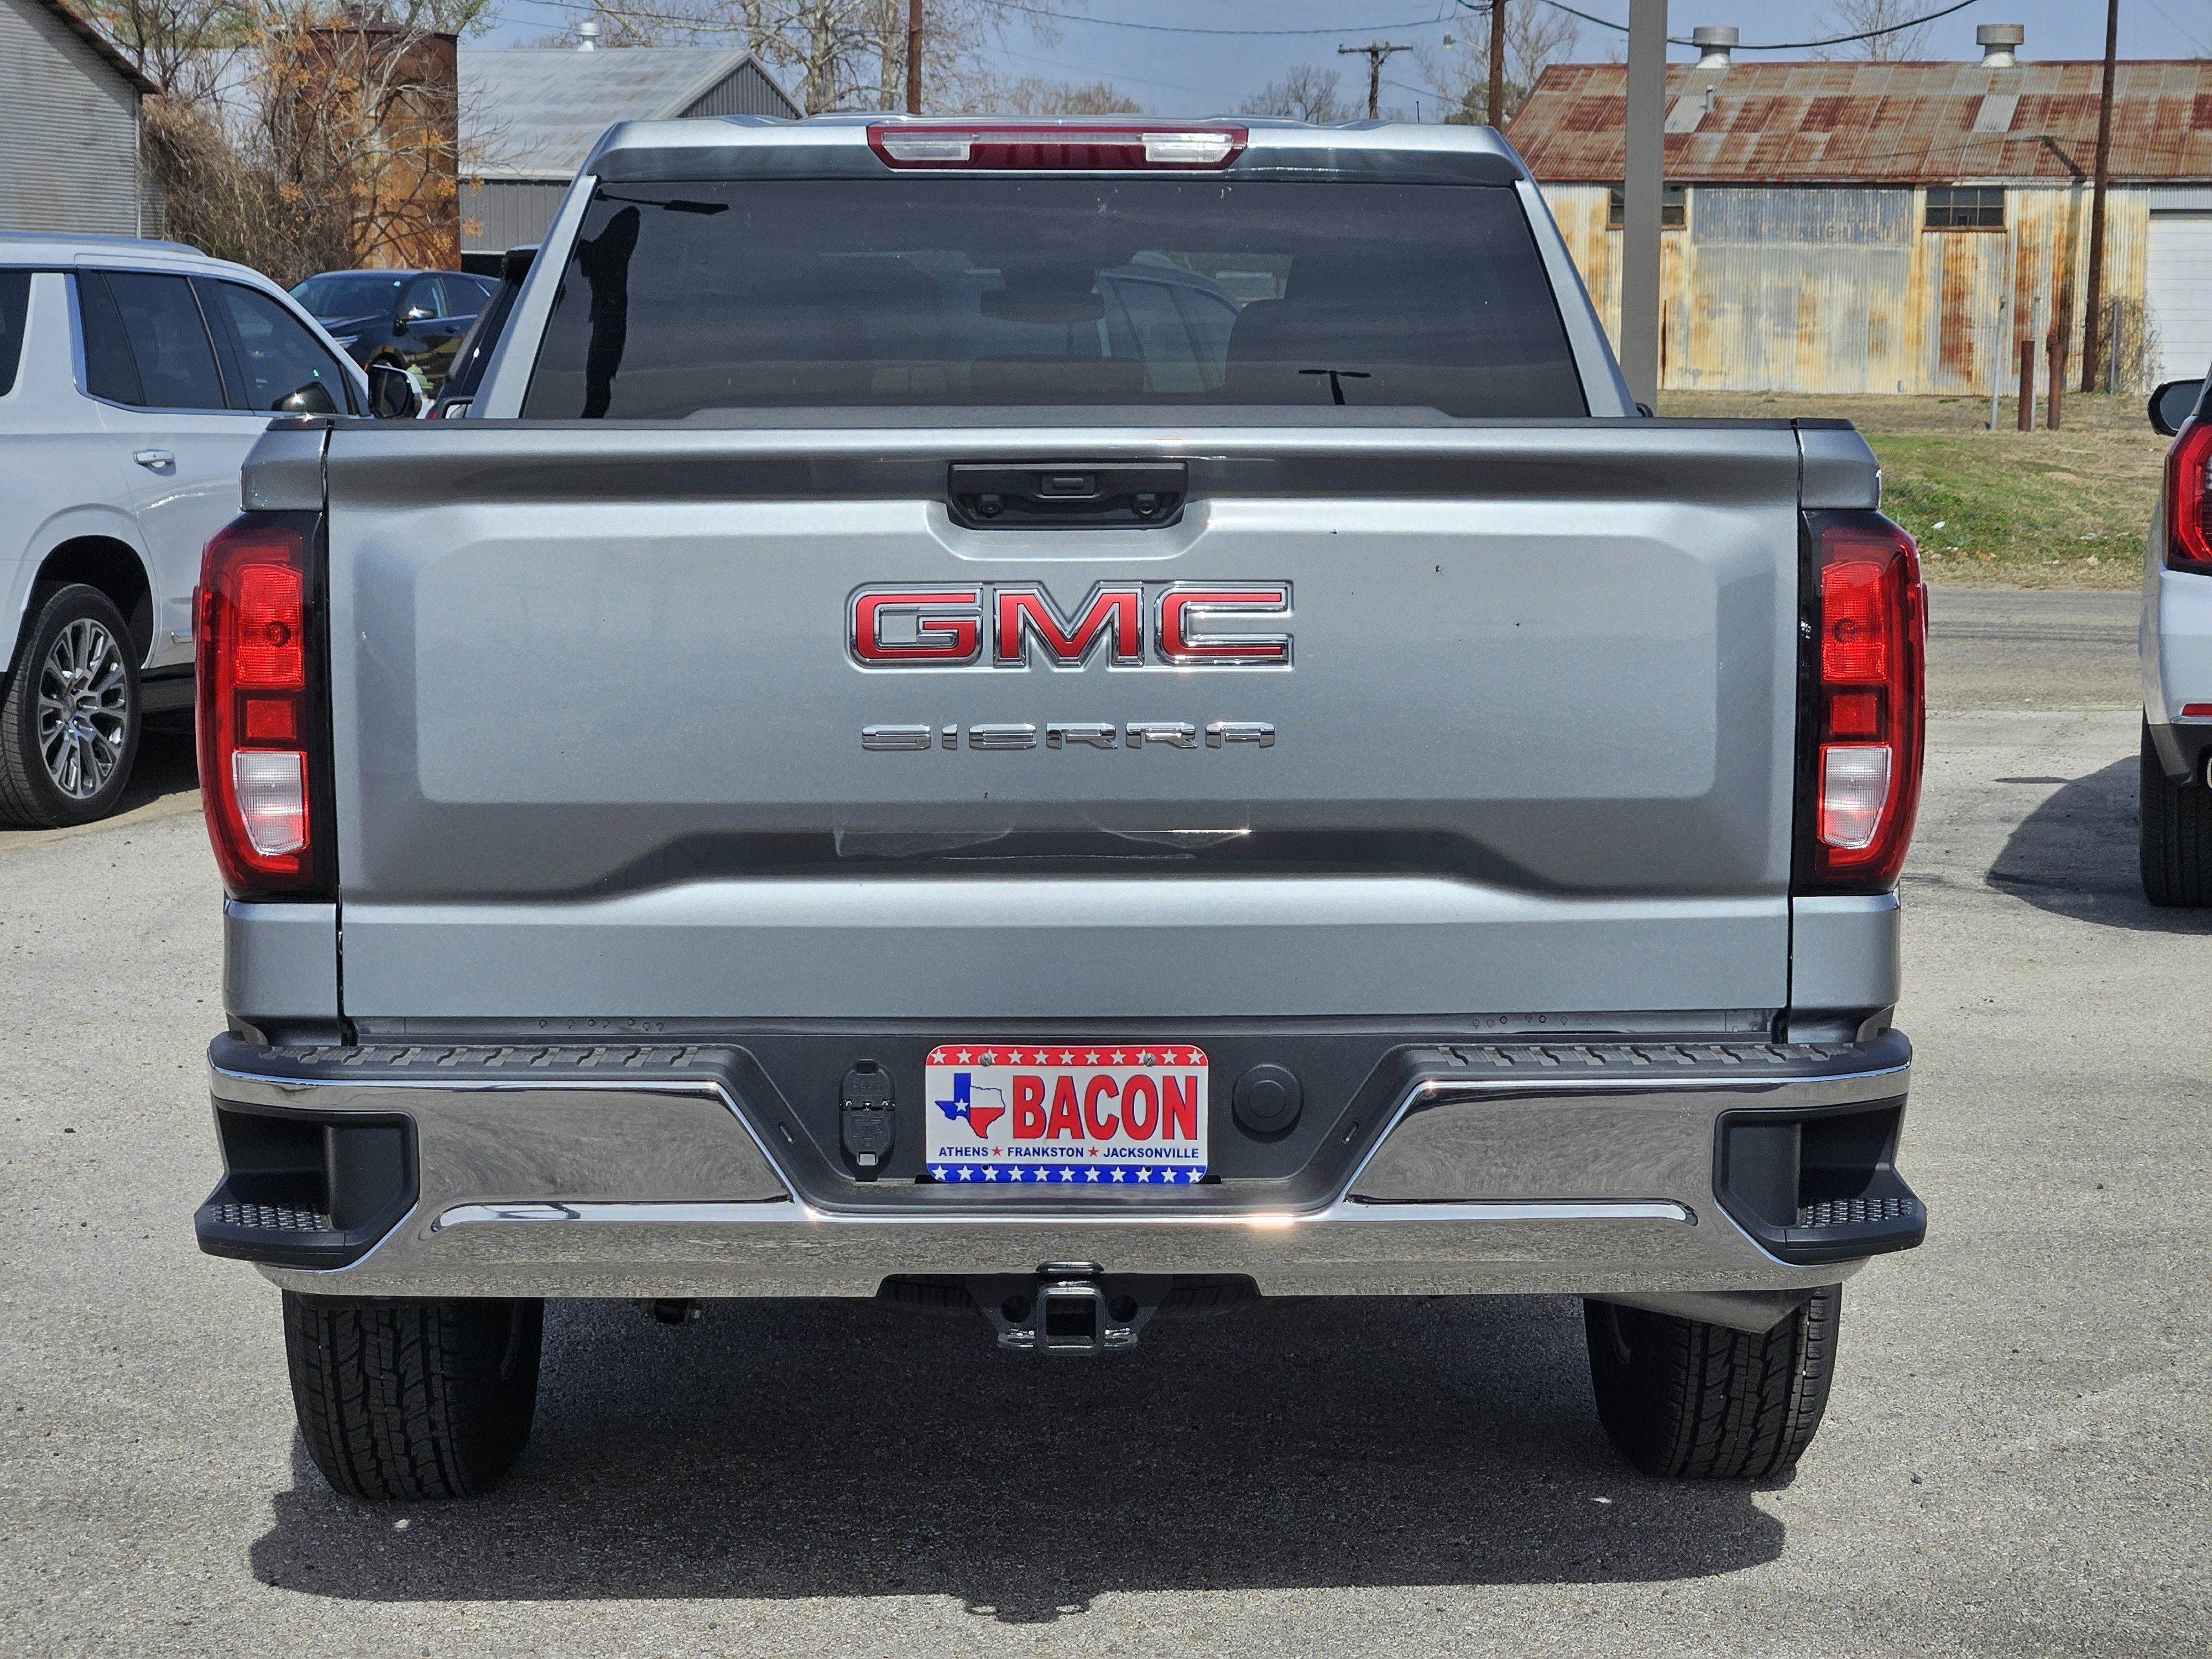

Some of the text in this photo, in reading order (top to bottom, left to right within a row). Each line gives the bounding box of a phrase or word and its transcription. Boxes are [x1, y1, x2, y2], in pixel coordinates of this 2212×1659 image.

[847, 583, 1294, 670] GMC
[862, 721, 1276, 751] SIERRA
[1013, 1074, 1198, 1140] BACON
[938, 1145, 1199, 1159] ATHENS FRANKSTON JACKSONVILLE
